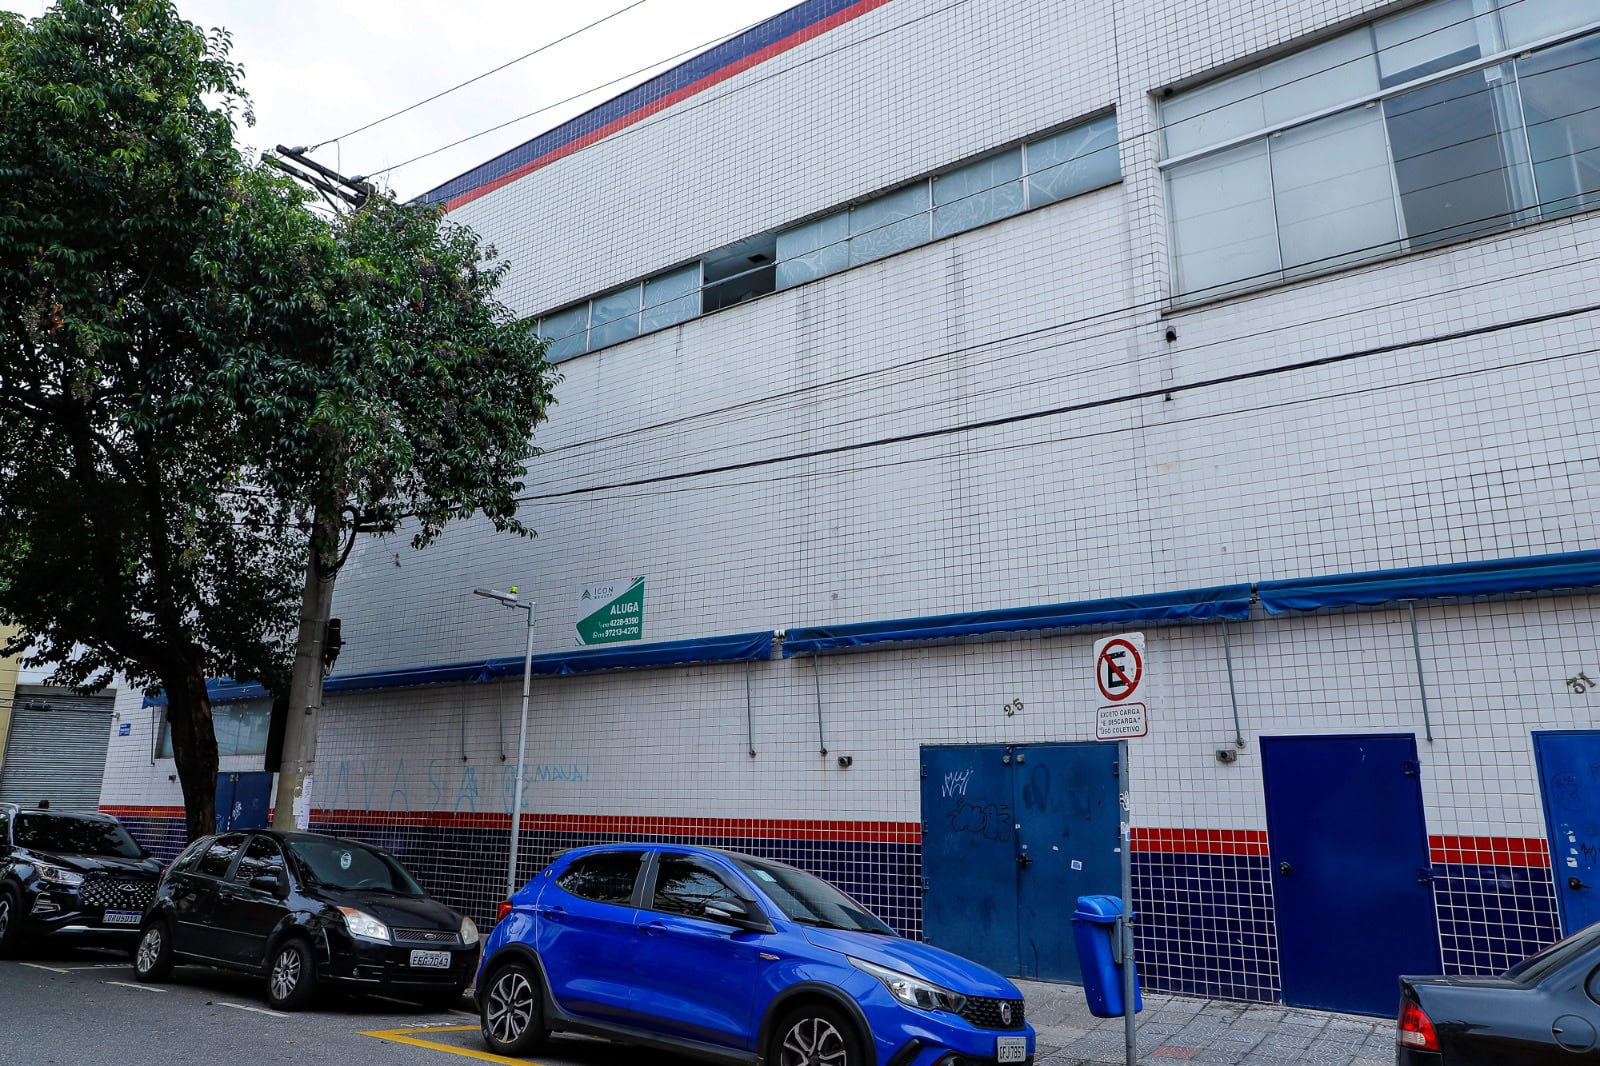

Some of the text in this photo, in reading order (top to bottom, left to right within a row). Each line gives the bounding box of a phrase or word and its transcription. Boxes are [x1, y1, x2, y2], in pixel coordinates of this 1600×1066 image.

[594, 586, 614, 595] ICON
[610, 602, 639, 615] ALUGA
[1566, 671, 1596, 695] 31
[1003, 697, 1024, 718] 25
[1119, 708, 1141, 716] CARGA
[1112, 725, 1140, 734] COLETIVO
